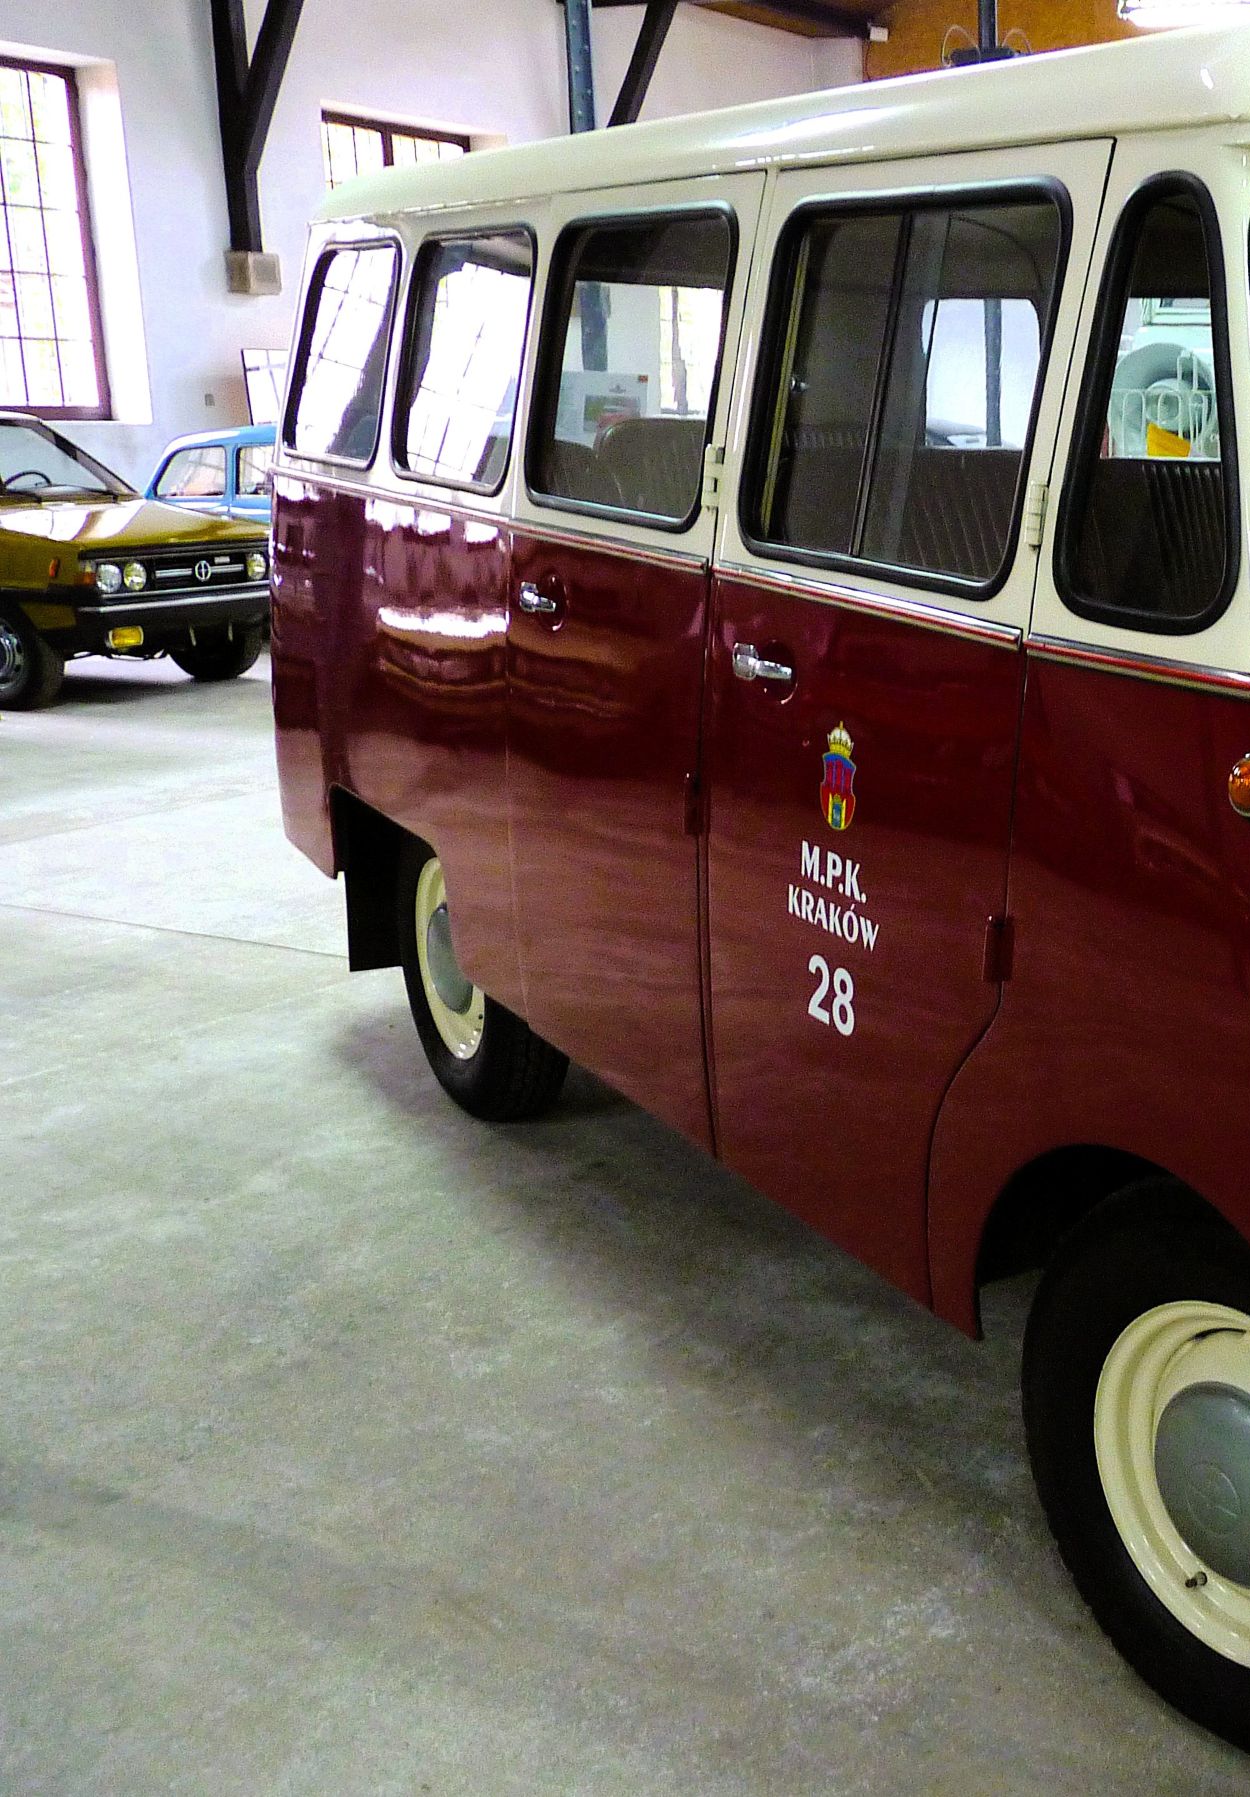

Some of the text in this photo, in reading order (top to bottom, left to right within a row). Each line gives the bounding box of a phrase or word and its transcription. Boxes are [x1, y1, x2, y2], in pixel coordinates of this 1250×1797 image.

[801, 840, 867, 903] M.P.K.
[788, 884, 879, 951] KRAKÓW
[808, 954, 854, 1036] 28
